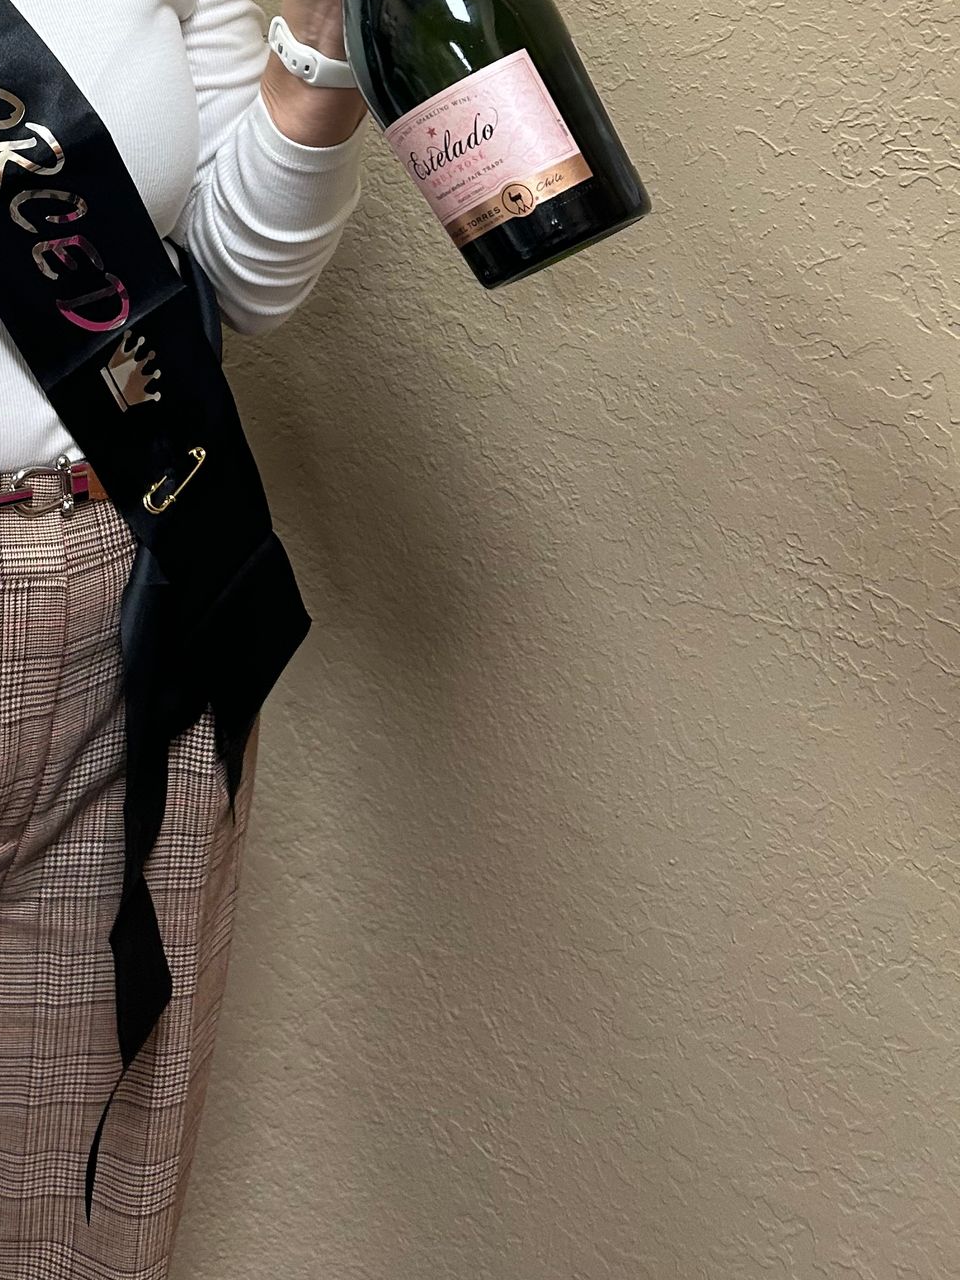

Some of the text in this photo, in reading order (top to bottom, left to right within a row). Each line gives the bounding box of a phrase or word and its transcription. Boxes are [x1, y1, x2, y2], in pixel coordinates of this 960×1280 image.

[416, 95, 471, 125] SPARKLING WINE
[407, 106, 499, 180] Estelado
[536, 173, 565, 192] Chile
[467, 206, 501, 229] TORRES
